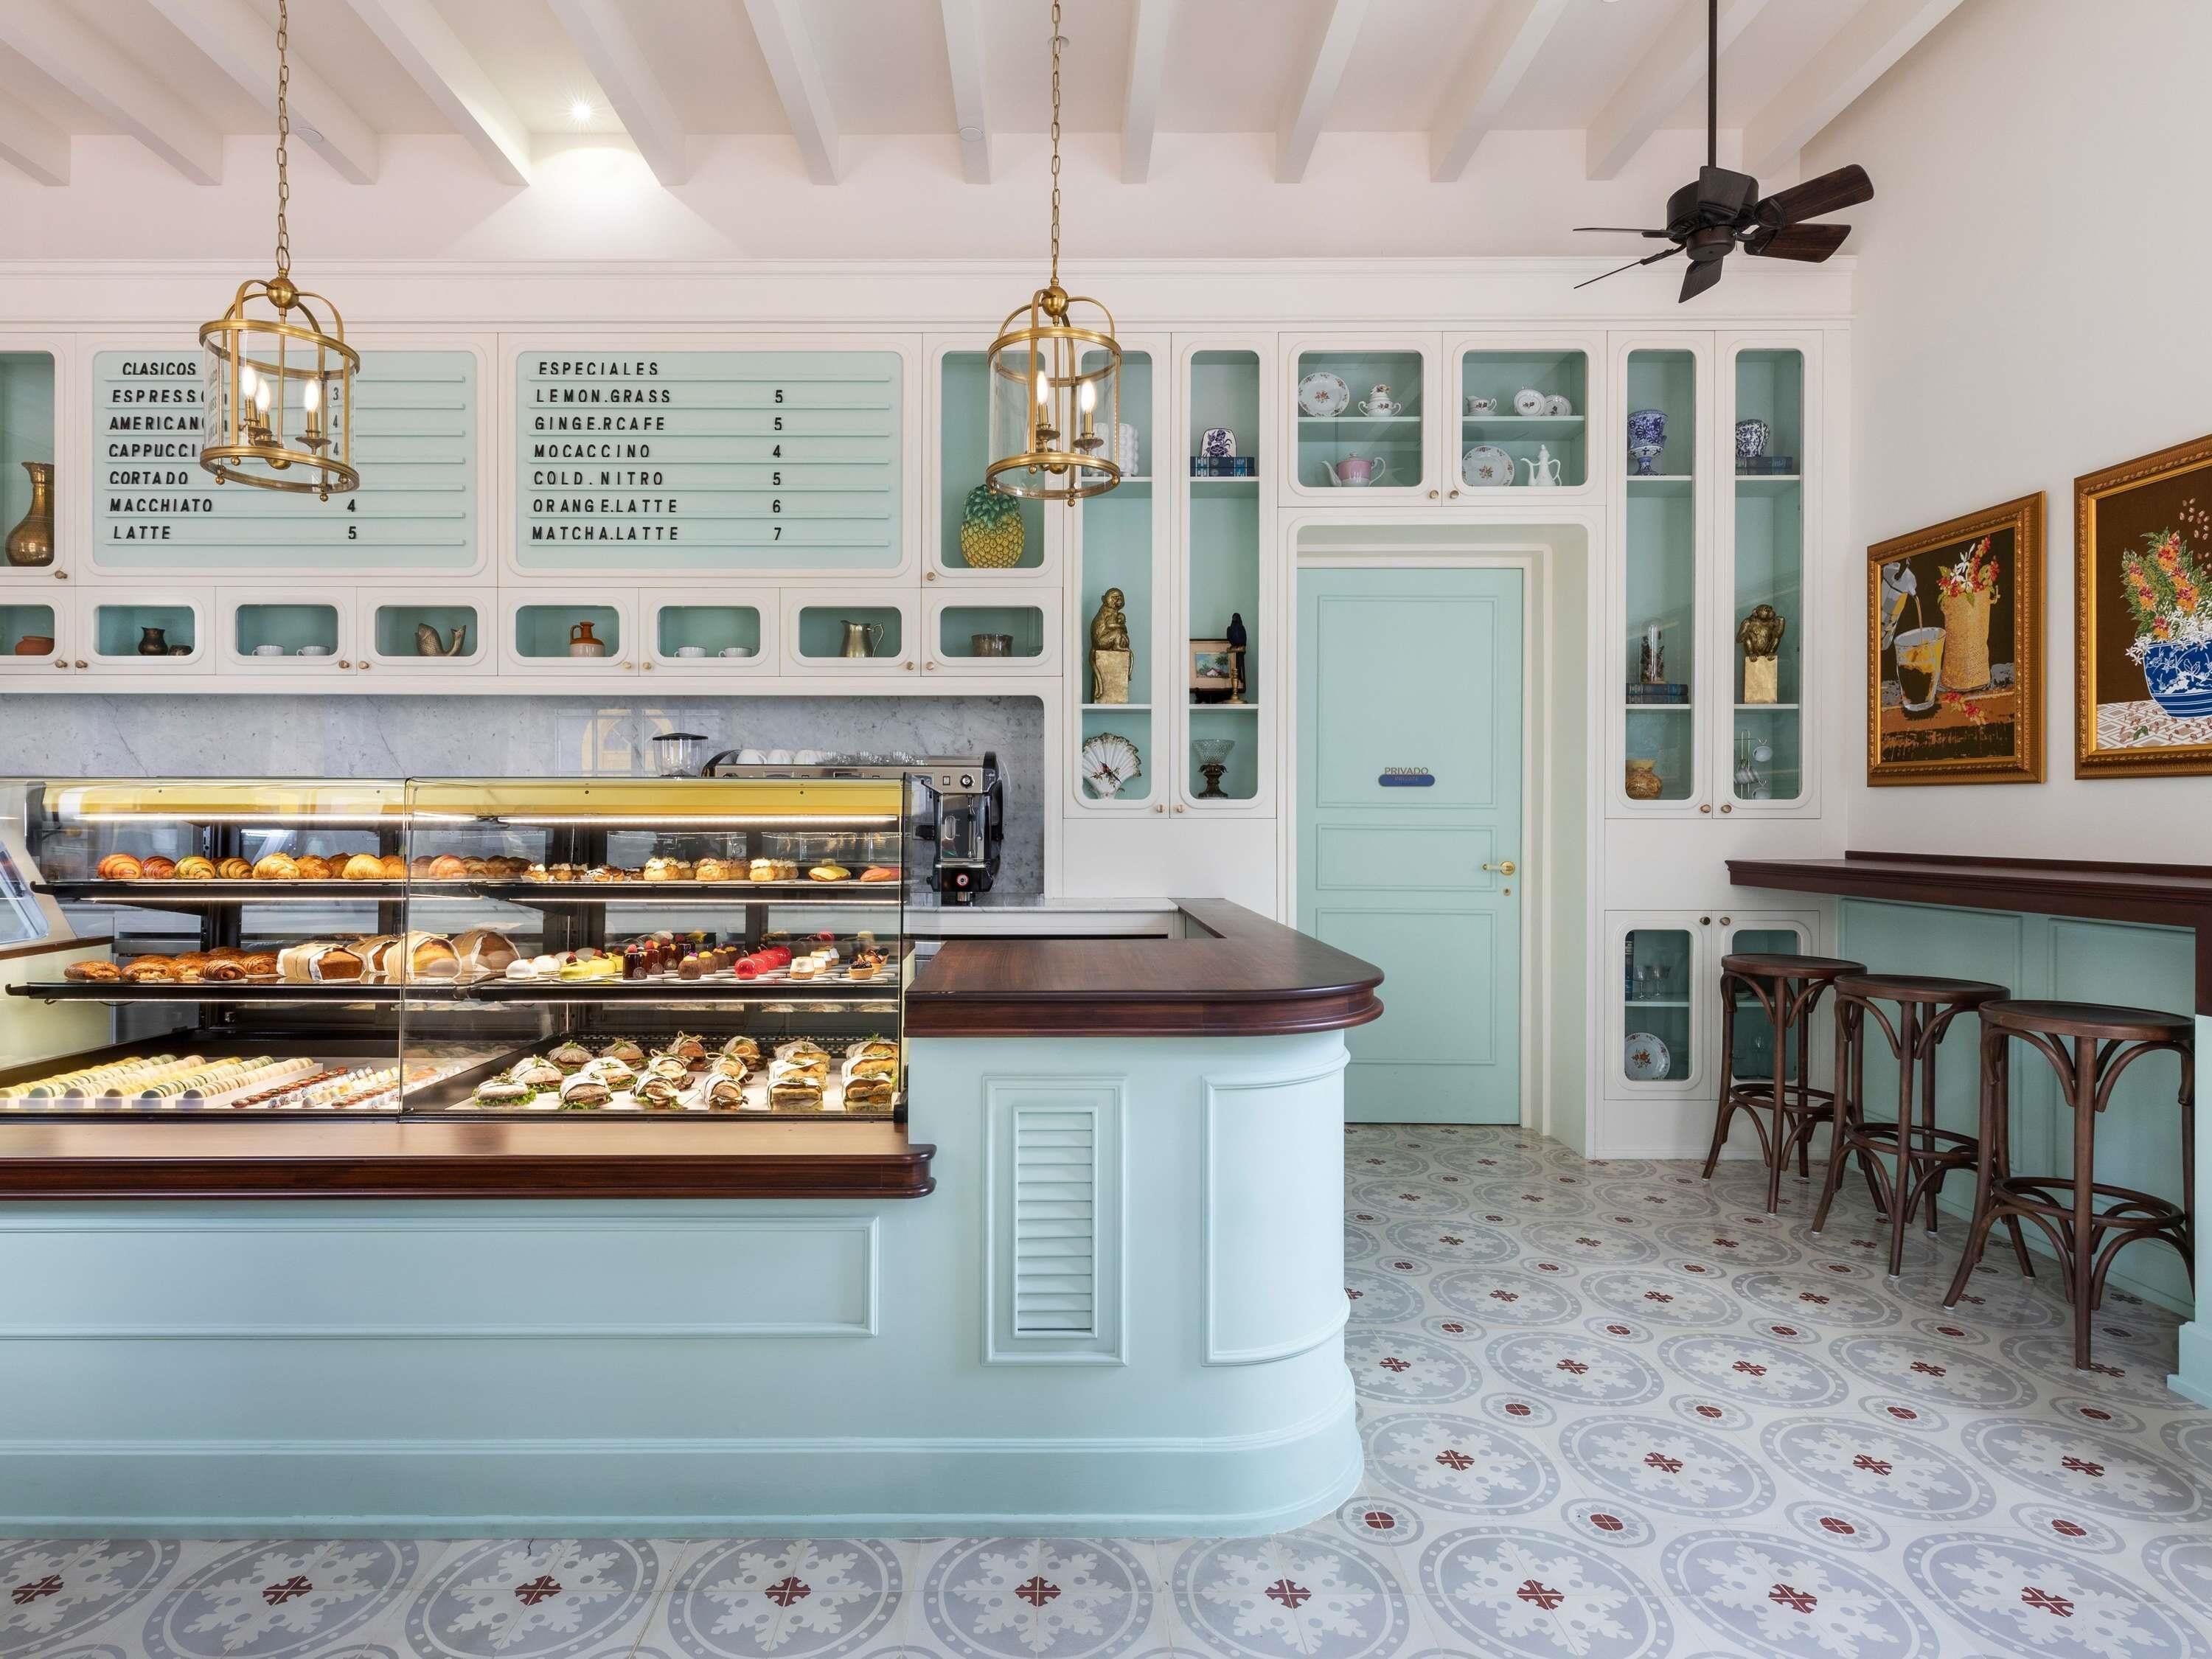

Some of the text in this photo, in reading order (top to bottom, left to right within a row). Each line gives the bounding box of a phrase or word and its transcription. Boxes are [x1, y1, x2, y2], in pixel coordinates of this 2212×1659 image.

[122, 362, 196, 375] CLASICOS
[539, 361, 658, 375] ESPECIALES
[112, 386, 341, 403] ESPRESS 3
[536, 389, 783, 403] LEMON.GRASS 5
[109, 414, 340, 431] AMERICAN 4
[774, 417, 782, 431] 5
[332, 442, 340, 456] 4
[534, 444, 782, 458] MOCACCINO 4
[109, 470, 188, 485] CORTADO
[773, 472, 781, 486] 5
[109, 498, 356, 512] MACCHIATO 4
[533, 498, 781, 513] ORANGE.LATTE 6
[114, 526, 357, 540] LATTE 5
[532, 526, 782, 541] MATCHA.LATTE 7
